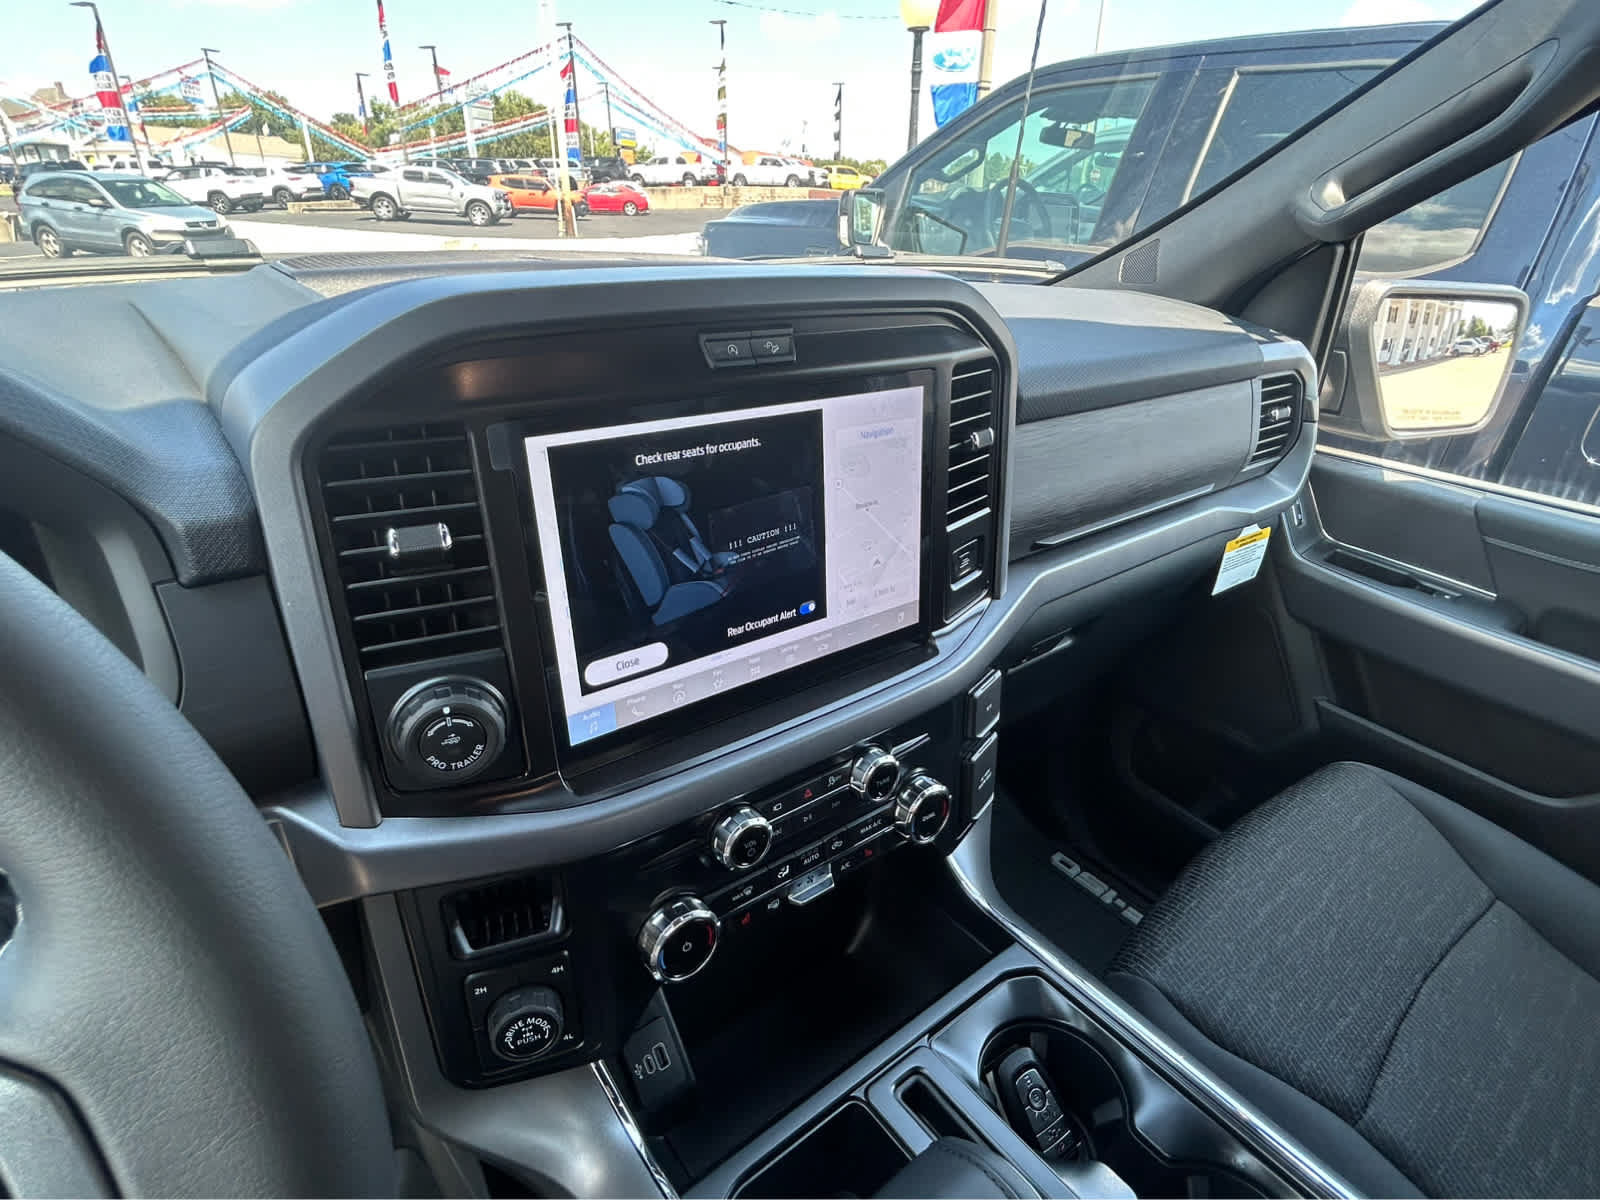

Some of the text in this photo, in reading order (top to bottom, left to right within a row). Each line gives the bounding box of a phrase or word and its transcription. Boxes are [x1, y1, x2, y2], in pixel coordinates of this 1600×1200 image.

[635, 437, 762, 466] Check rear seats for occupants.
[746, 528, 780, 544] CAUTION
[727, 608, 797, 638] Rear Occupant Alert
[615, 657, 641, 672] Close
[426, 744, 485, 770] PRO TRAILER
[803, 853, 820, 865] AUTO
[551, 965, 564, 974] 4H
[474, 986, 488, 996] 2H
[504, 1017, 551, 1043] DRIVE MODE
[563, 1033, 574, 1041] 4L
[517, 1034, 542, 1046] PUSH
